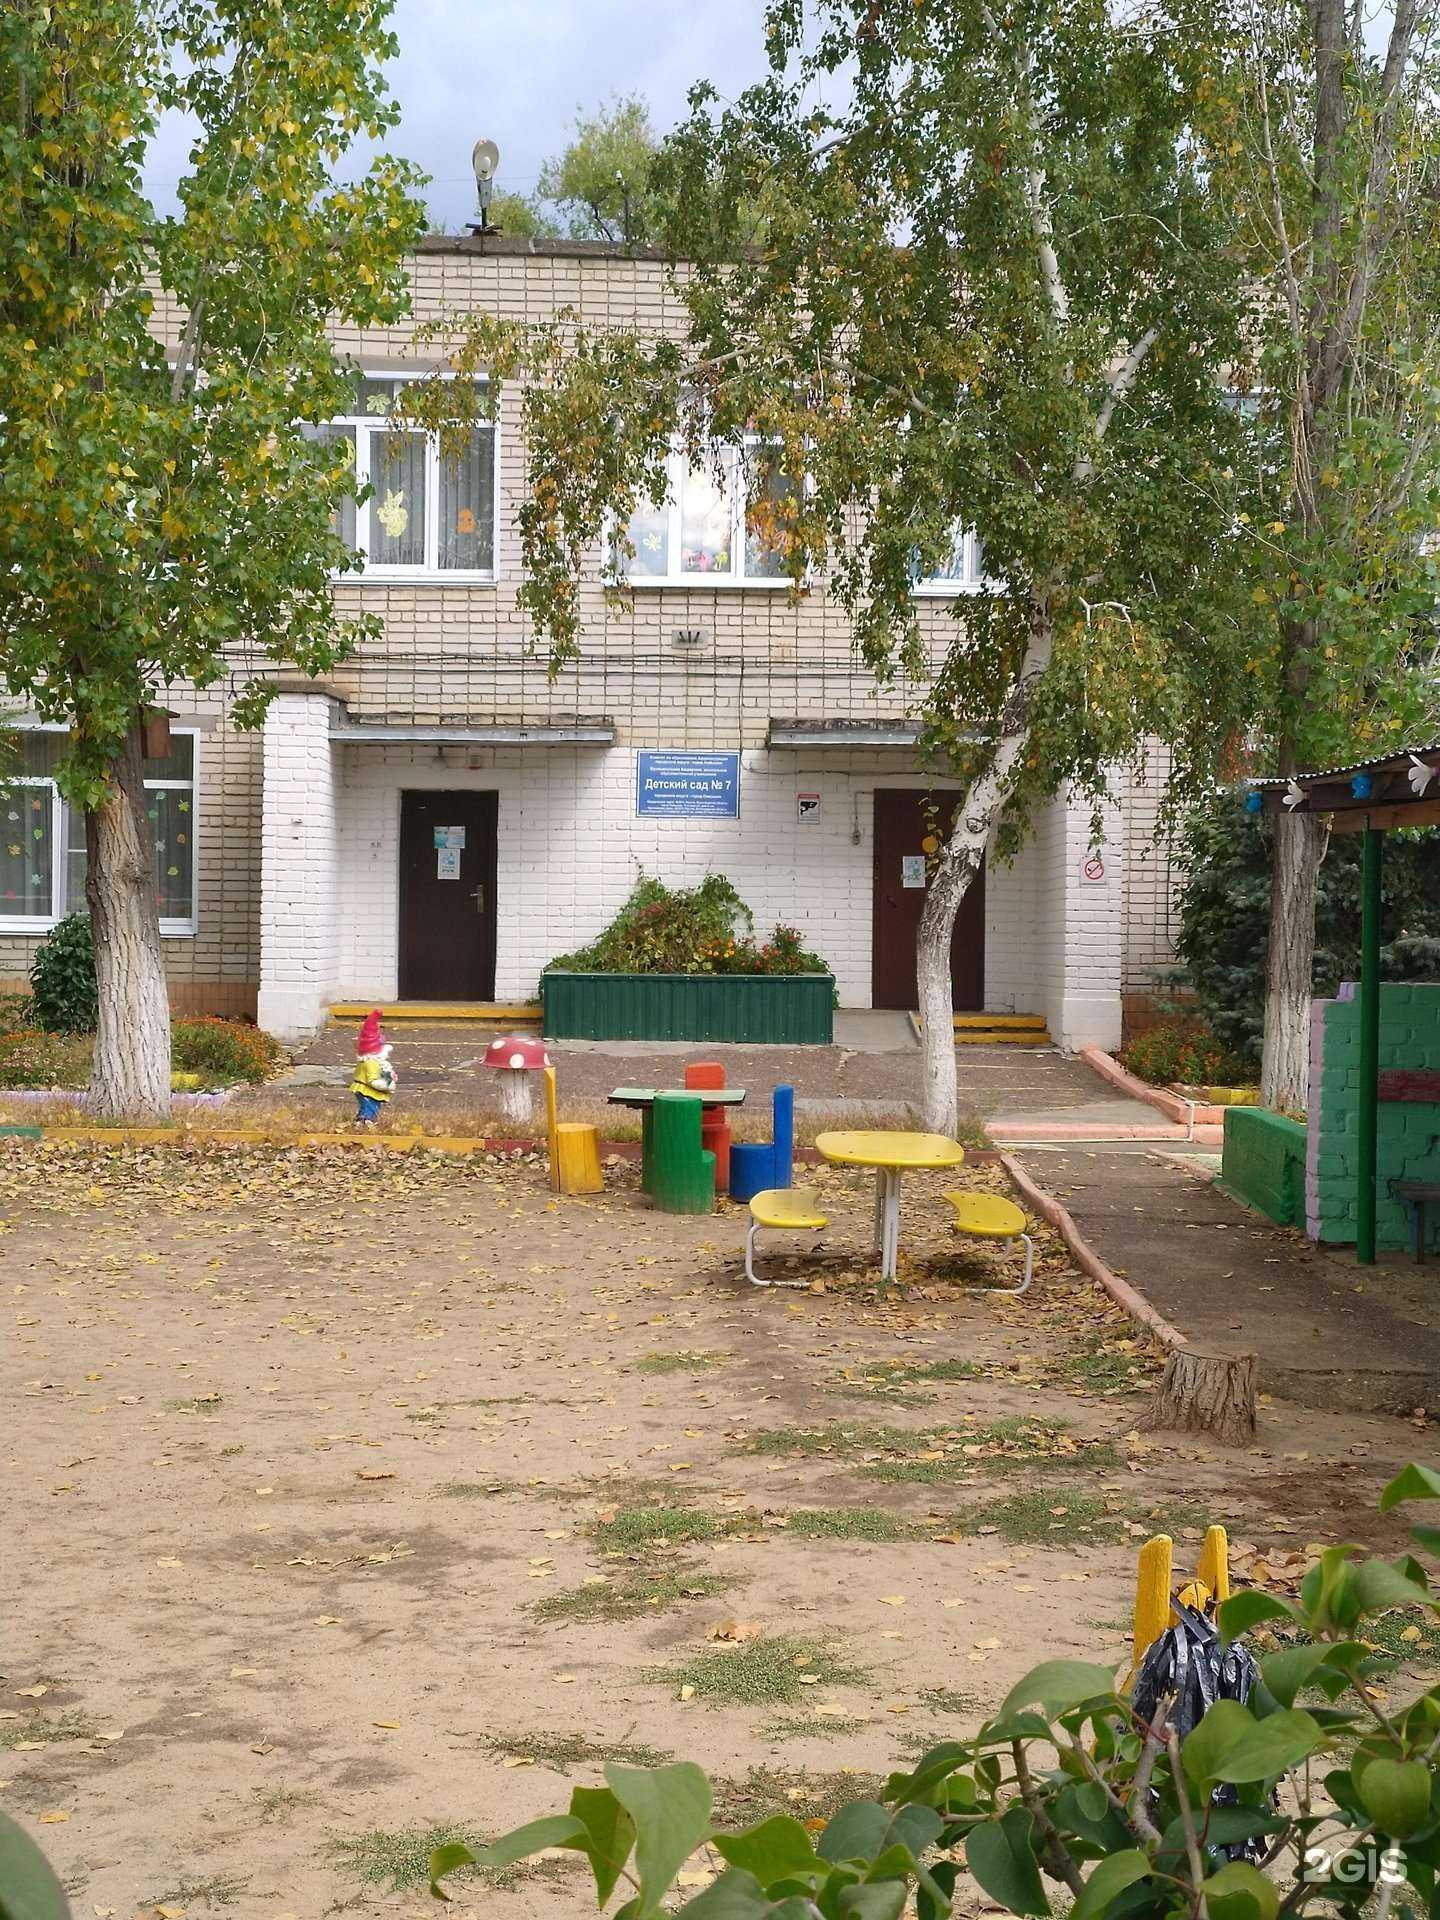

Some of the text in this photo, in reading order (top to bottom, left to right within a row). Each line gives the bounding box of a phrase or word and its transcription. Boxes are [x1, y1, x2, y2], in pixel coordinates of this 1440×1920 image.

[645, 779, 731, 791] Детский сад № 7
